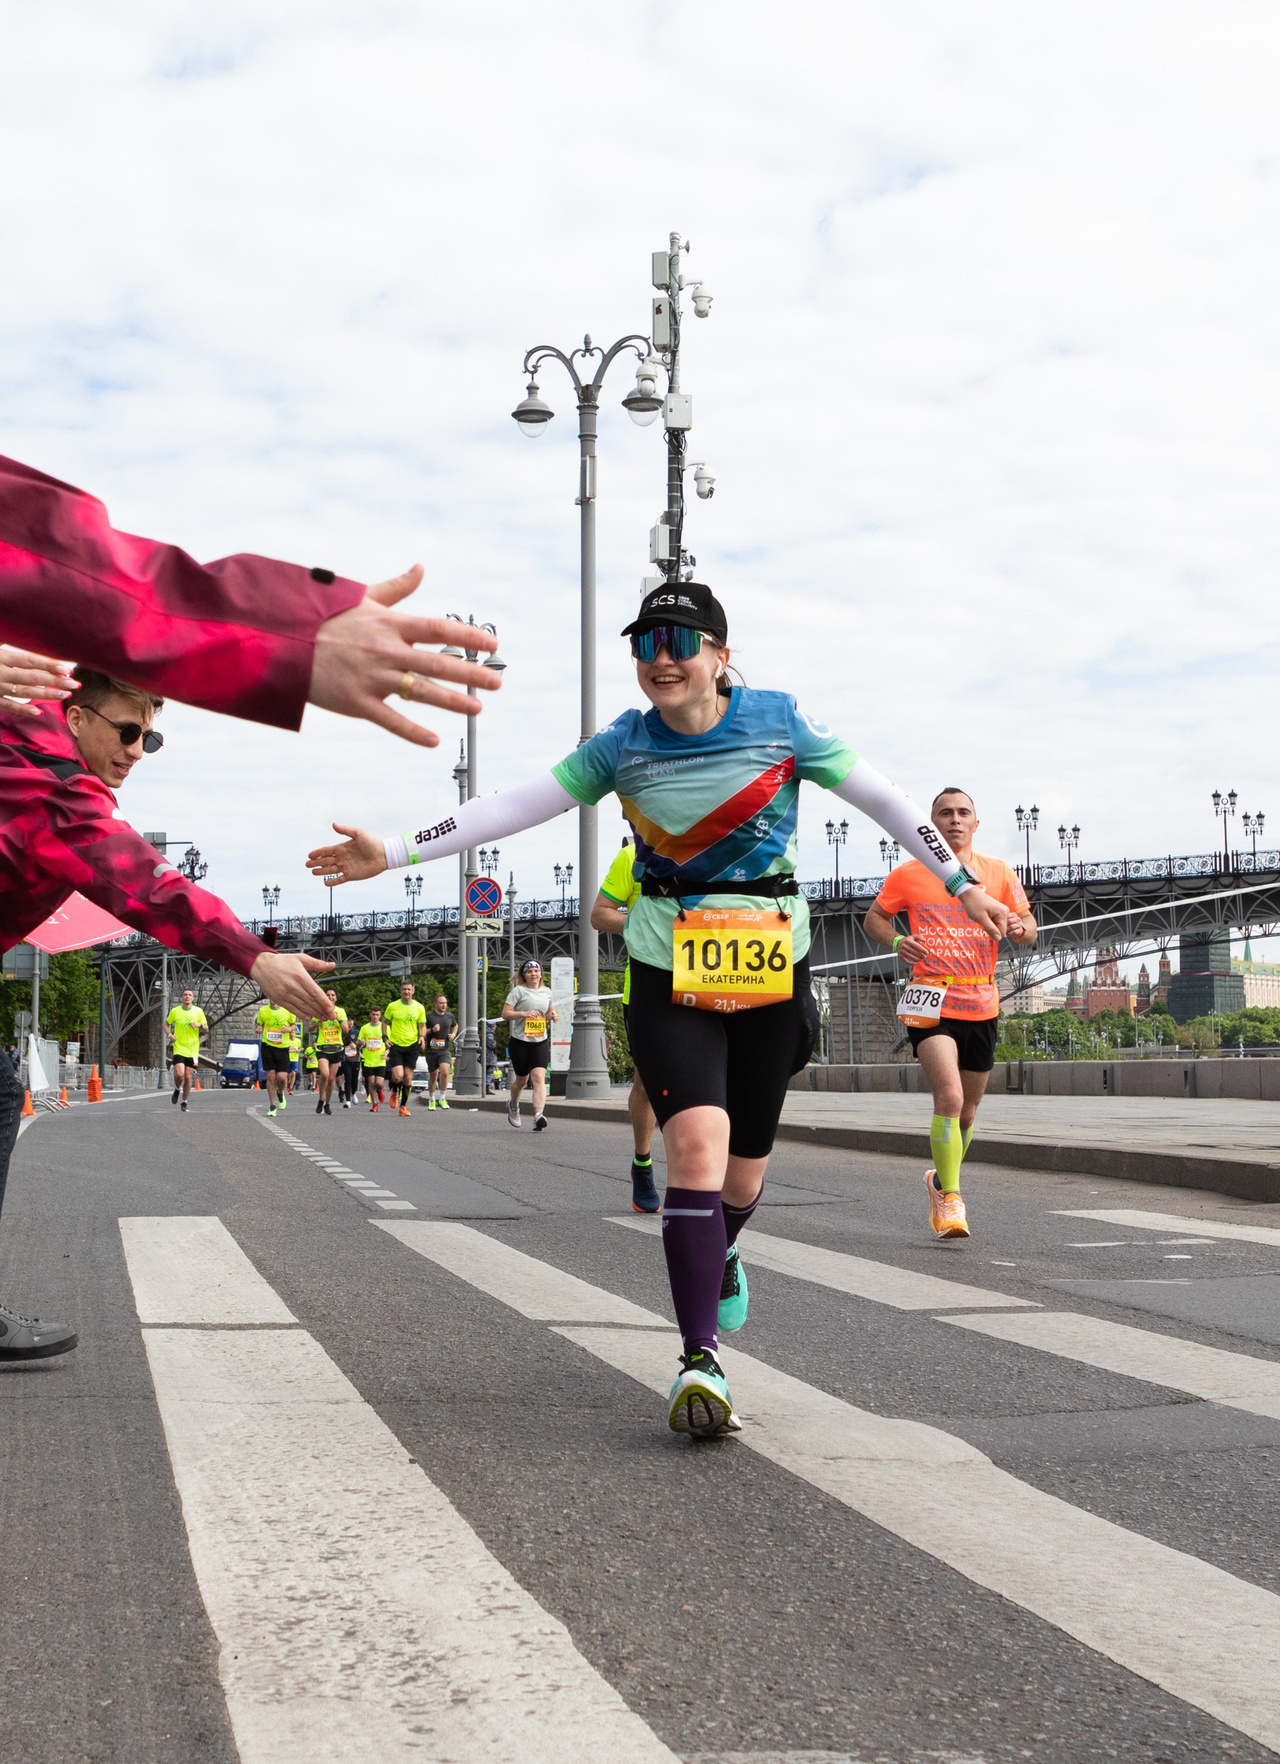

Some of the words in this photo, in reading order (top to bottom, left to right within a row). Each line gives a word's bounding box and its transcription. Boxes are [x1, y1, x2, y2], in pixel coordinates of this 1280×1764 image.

[650, 594, 676, 608] SCS
[647, 756, 705, 770] TRIATHLON
[645, 769, 676, 779] TEAM
[925, 937, 950, 947] ОЛУ
[681, 939, 787, 972] 10136
[928, 948, 975, 959] АРАФОН
[701, 974, 765, 985] ЕКАТЕРИНА
[901, 988, 941, 1007] 10378
